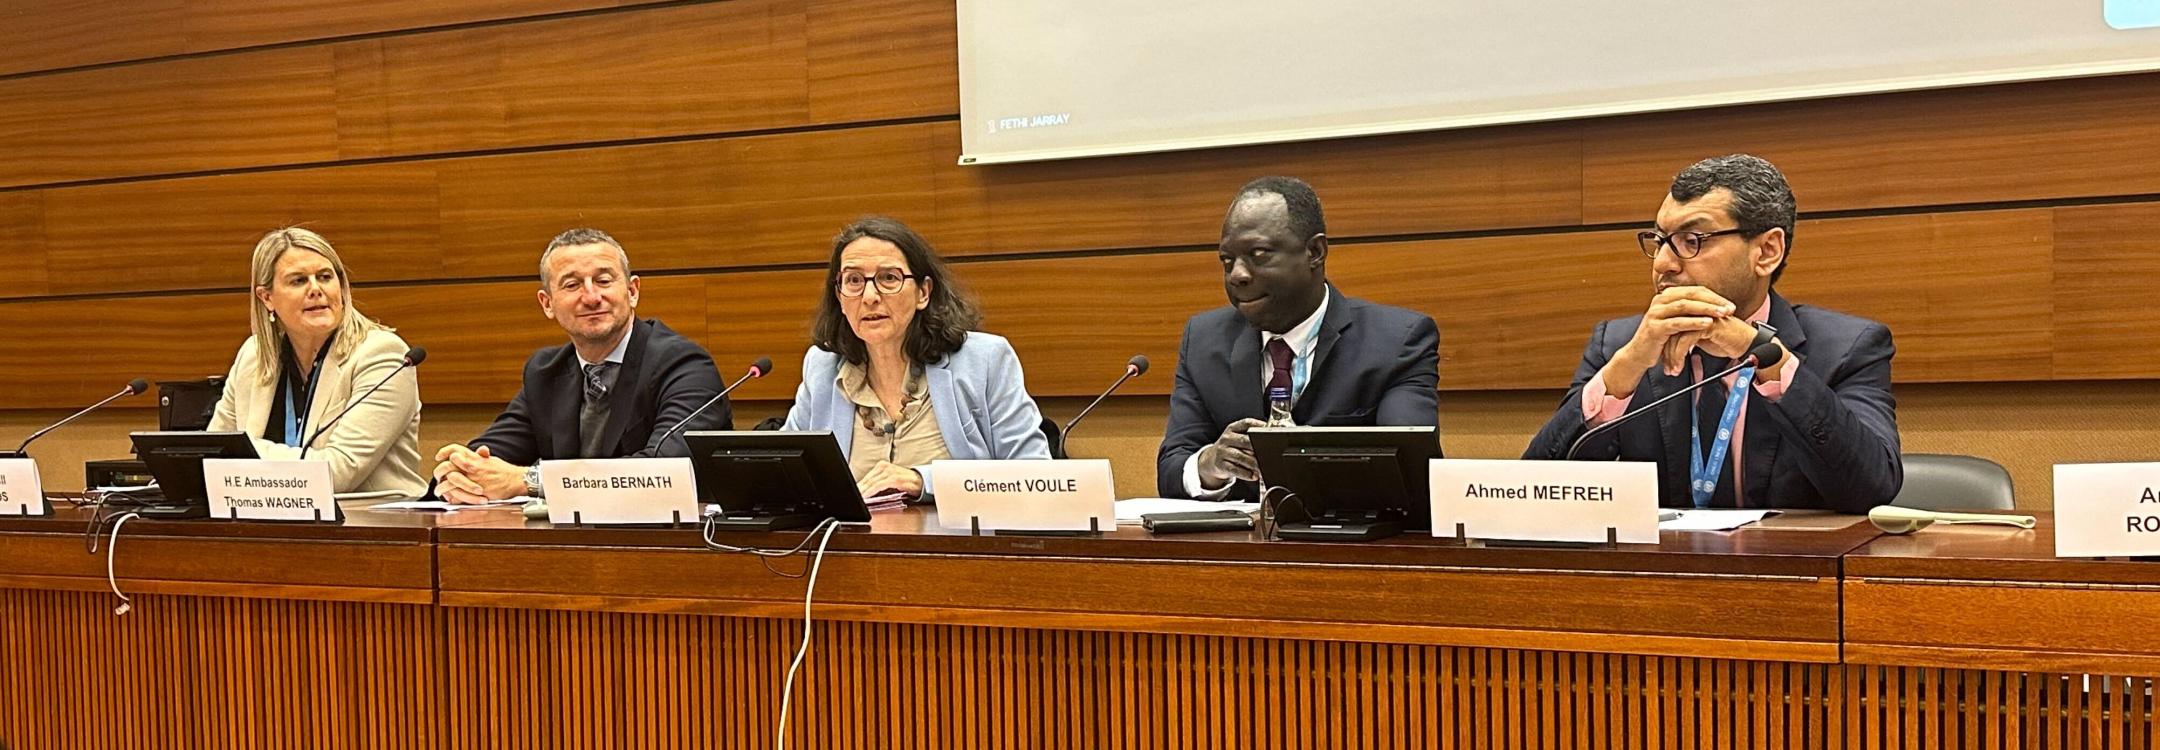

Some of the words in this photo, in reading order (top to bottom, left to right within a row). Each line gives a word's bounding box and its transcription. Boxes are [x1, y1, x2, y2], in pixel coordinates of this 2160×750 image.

[1000, 116, 1028, 130] FETHI
[1030, 113, 1070, 127] JARRAY
[244, 476, 308, 489] Ambassador
[562, 477, 608, 489] Barbara
[611, 476, 672, 489] BERNATH
[964, 479, 1021, 492] Clément
[1025, 479, 1077, 492] VOULE
[1465, 484, 1527, 499] Ahmed
[1534, 485, 1613, 501] MEFREH
[2139, 487, 2160, 503] A
[224, 496, 263, 508] Thomas
[265, 497, 314, 509] WAGNER
